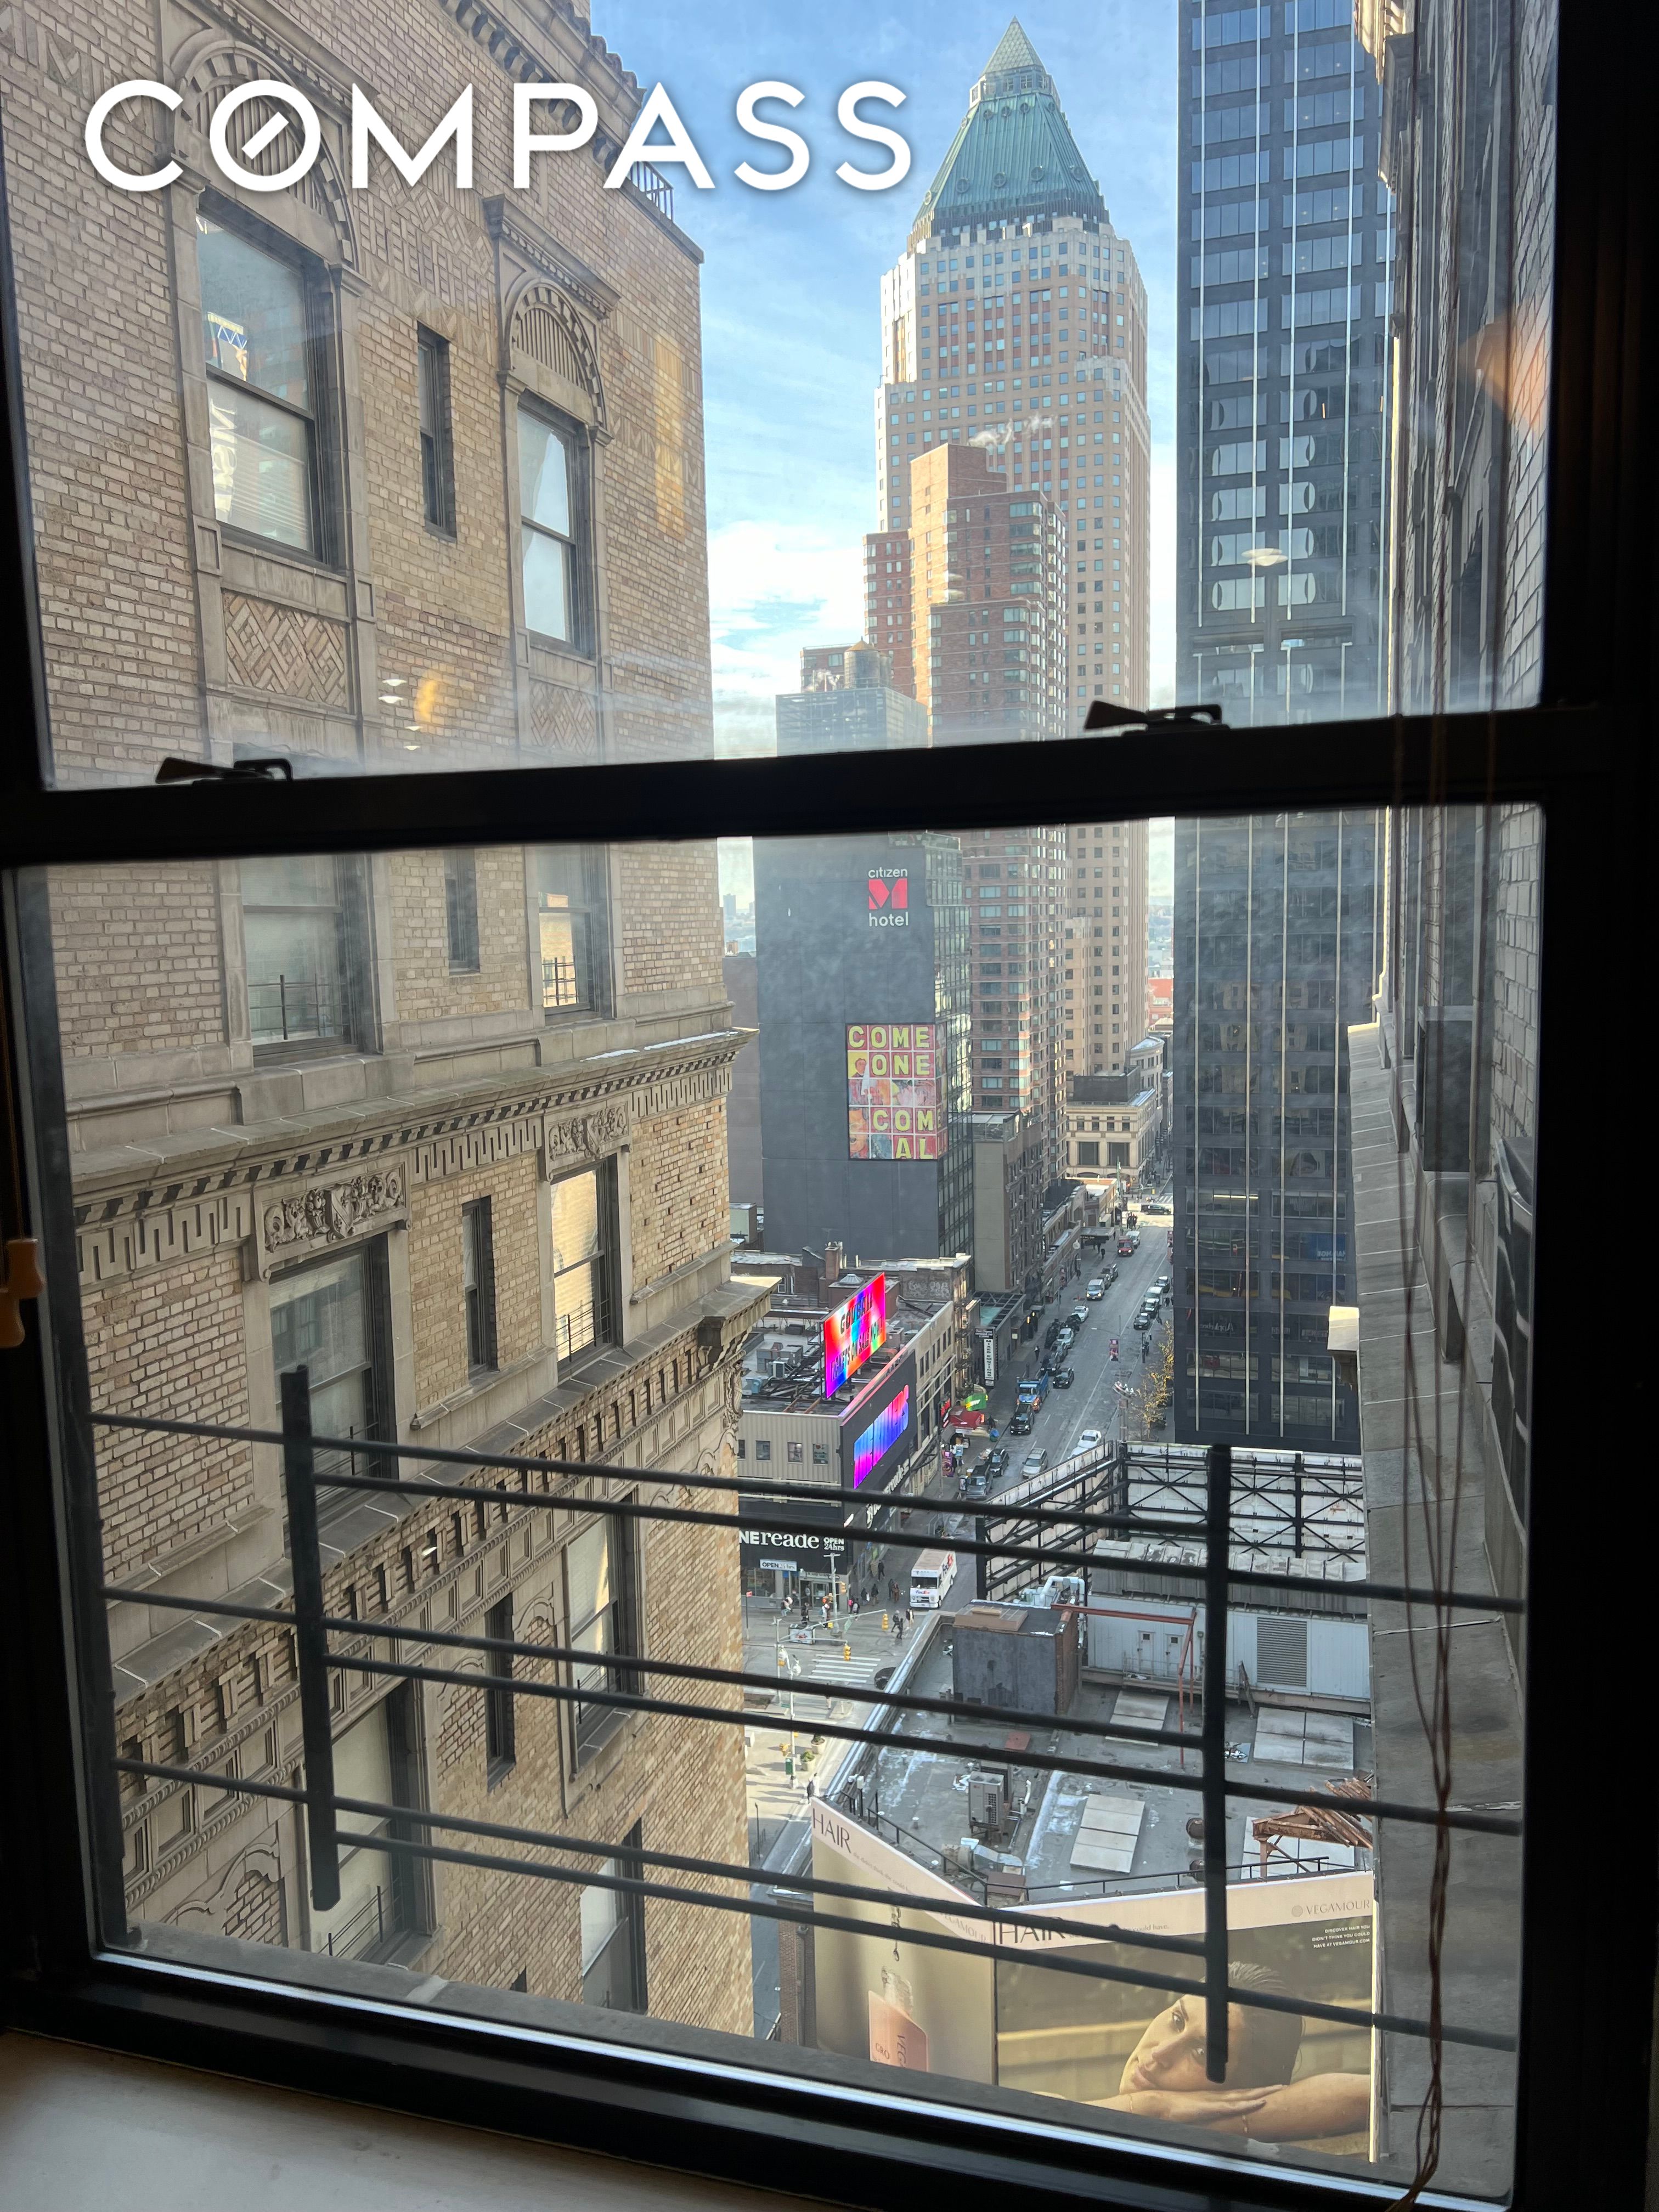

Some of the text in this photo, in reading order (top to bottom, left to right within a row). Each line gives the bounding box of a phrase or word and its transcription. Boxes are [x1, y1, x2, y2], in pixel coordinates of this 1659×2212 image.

[868, 866, 908, 878] citizen
[868, 911, 909, 927] hotel
[848, 1026, 930, 1048] COME
[871, 1054, 931, 1076] ONE
[823, 1537, 845, 1545] OPEN
[823, 1543, 845, 1551] 24hrs
[812, 1808, 851, 1854] HAIR
[1306, 1899, 1370, 1915] VEGAMOUR
[1333, 1938, 1370, 1946] VEGAMOUR.COM
